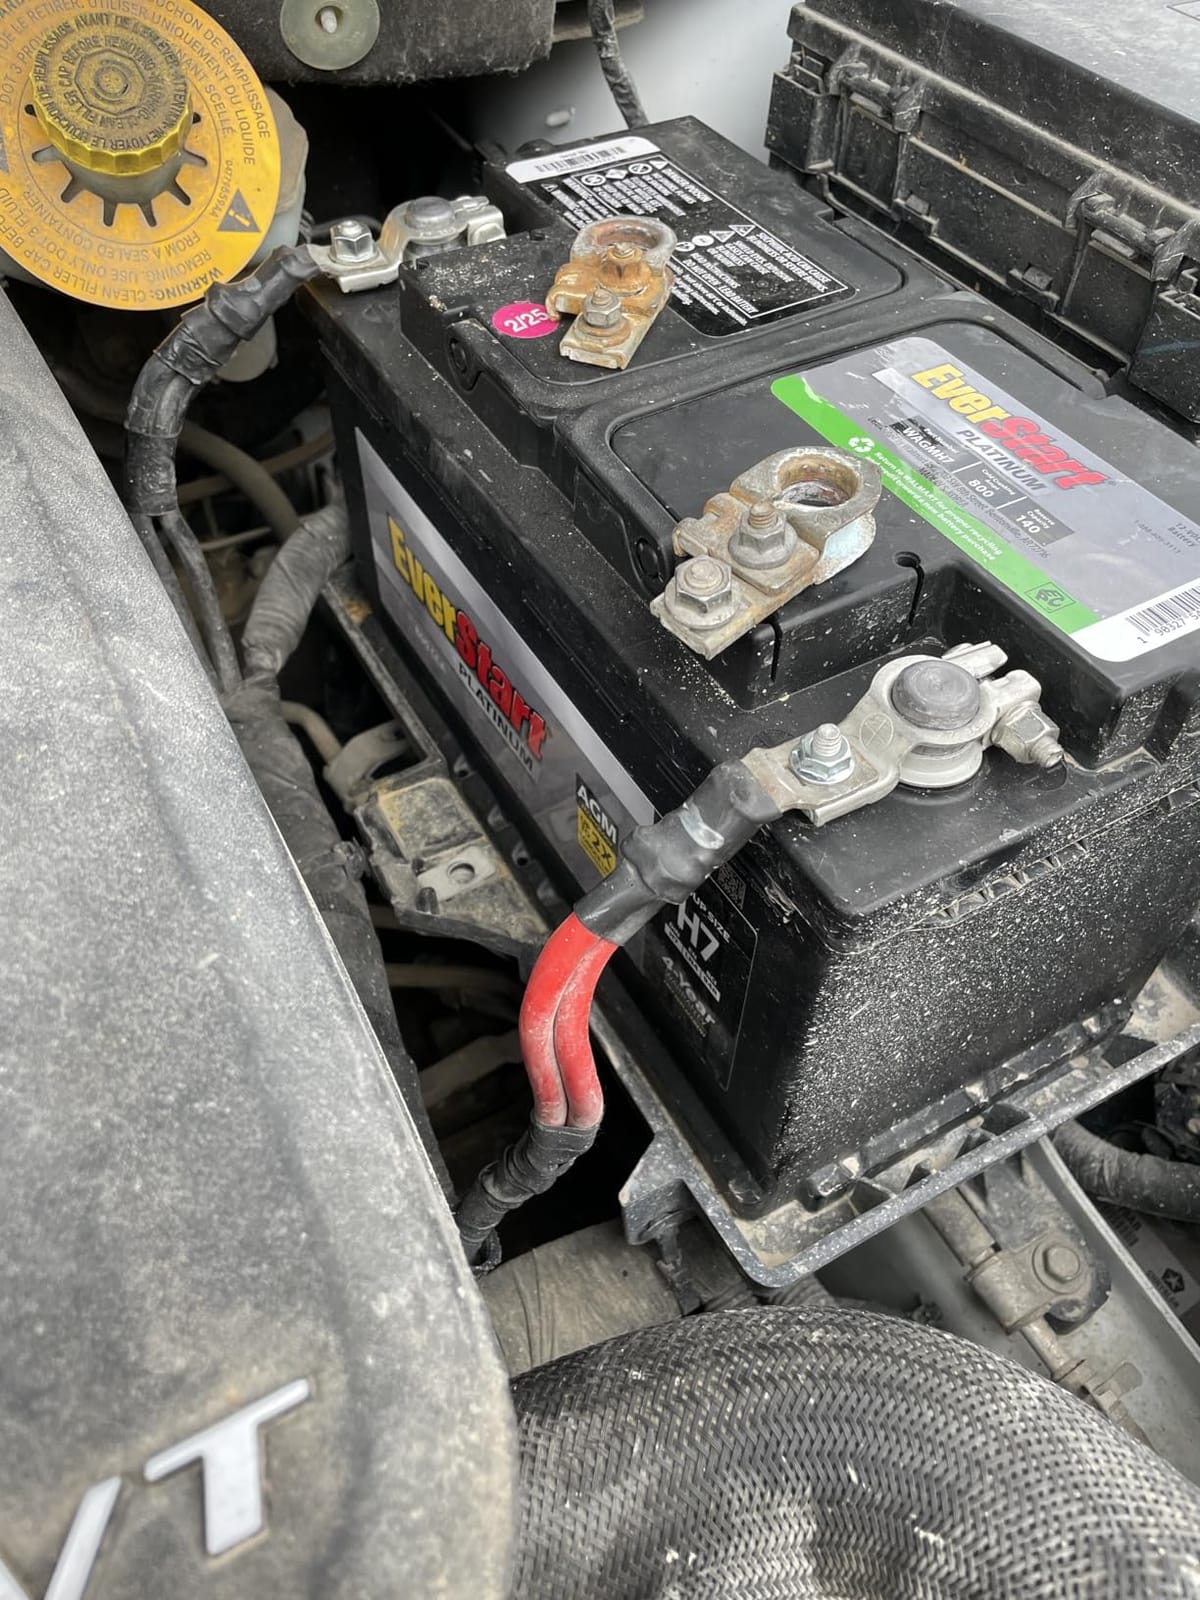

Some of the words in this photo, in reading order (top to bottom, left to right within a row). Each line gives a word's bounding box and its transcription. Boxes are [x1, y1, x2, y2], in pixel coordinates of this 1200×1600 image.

[151, 11, 228, 82] UNIQUEMENT
[224, 83, 242, 106] DU
[235, 108, 255, 165] LIQUIDE
[203, 28, 221, 48] DE
[219, 47, 271, 139] REMPLISSAGE
[24, 249, 51, 270] CAP
[164, 230, 201, 256] FROM
[53, 266, 98, 295] FILLER
[102, 286, 146, 302] CLEAN
[151, 266, 224, 301] WARNING:
[503, 308, 549, 333] 2/25
[910, 362, 1110, 490] EverStart
[902, 426, 955, 463] WAGMH7
[956, 429, 1048, 492] PLATINUM
[902, 474, 938, 502] WALMART
[968, 479, 994, 498] 800
[1016, 514, 1041, 534] 140
[387, 514, 548, 762] EverStart
[458, 661, 535, 773] PLATINUM
[577, 784, 617, 845] AGM
[676, 899, 720, 962] H7
[707, 910, 732, 944] SIZE
[661, 955, 716, 1025] 4-Year
